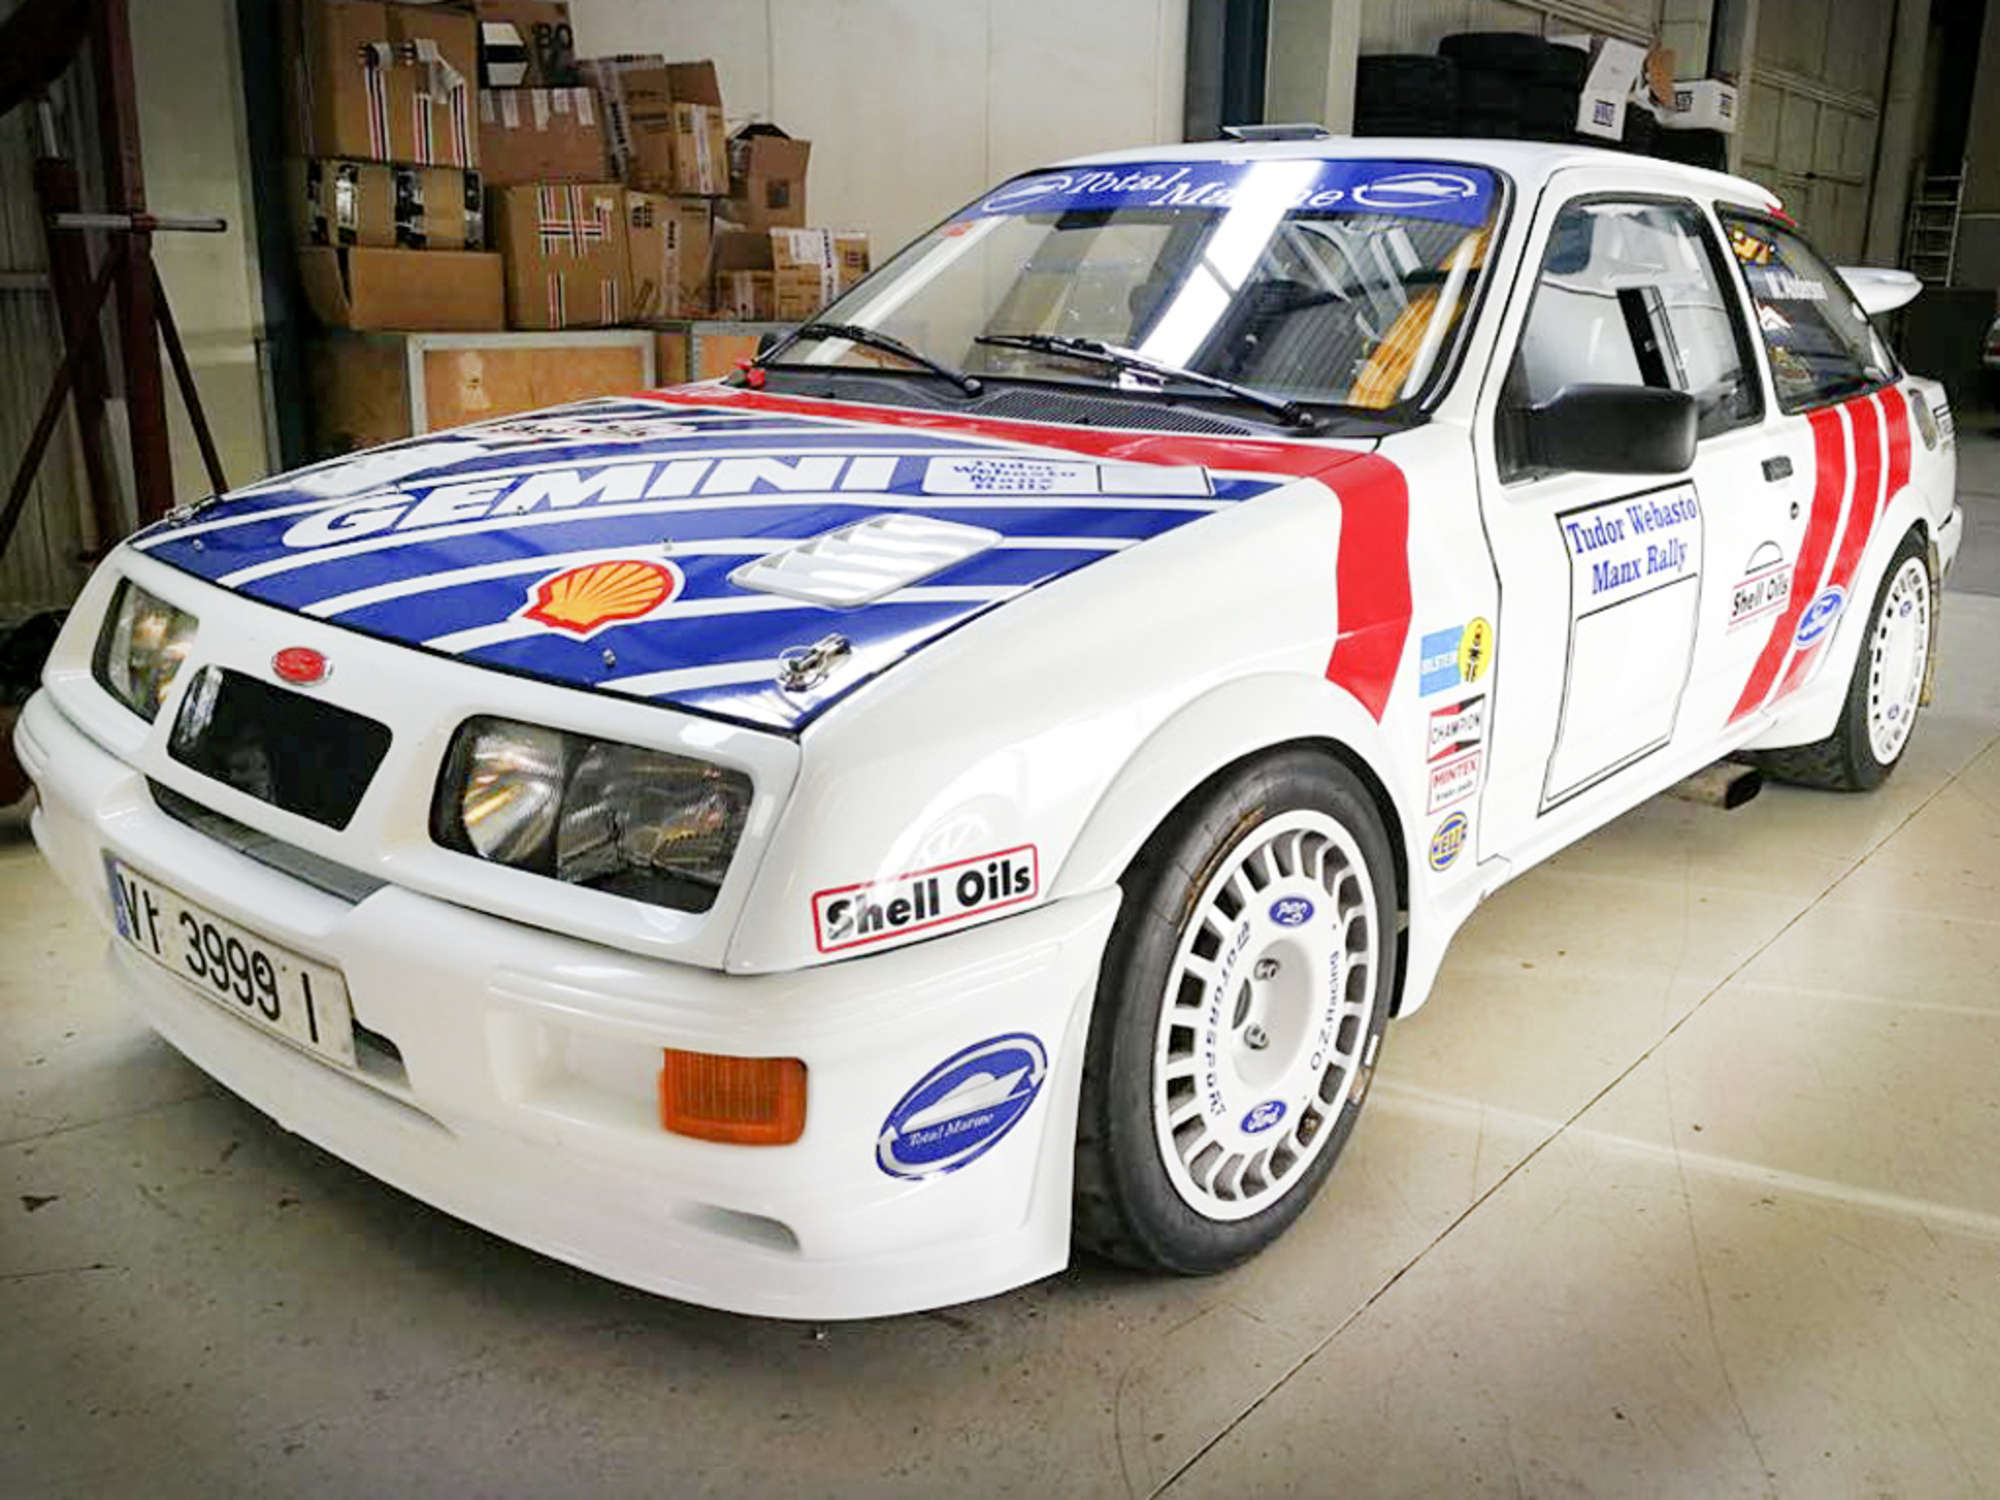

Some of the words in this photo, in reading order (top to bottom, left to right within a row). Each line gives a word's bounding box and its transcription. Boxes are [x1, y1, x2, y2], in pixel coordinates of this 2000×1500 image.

[1069, 167, 1193, 195] Total
[282, 456, 900, 548] GEMINI
[1566, 515, 1625, 554] Tudor
[1625, 497, 1697, 536] Webasto
[1591, 558, 1642, 595] Manx
[1646, 538, 1688, 576] Rally
[1731, 582, 1766, 617] Shell
[1766, 573, 1790, 601] Oils
[1432, 711, 1481, 745] CHAMPION
[1432, 758, 1477, 789] MINTEX
[826, 876, 941, 941] Shell
[956, 859, 1032, 908] Oils
[178, 910, 282, 1022] 3999
[907, 1124, 945, 1147] Total
[944, 1112, 995, 1138] Marine
